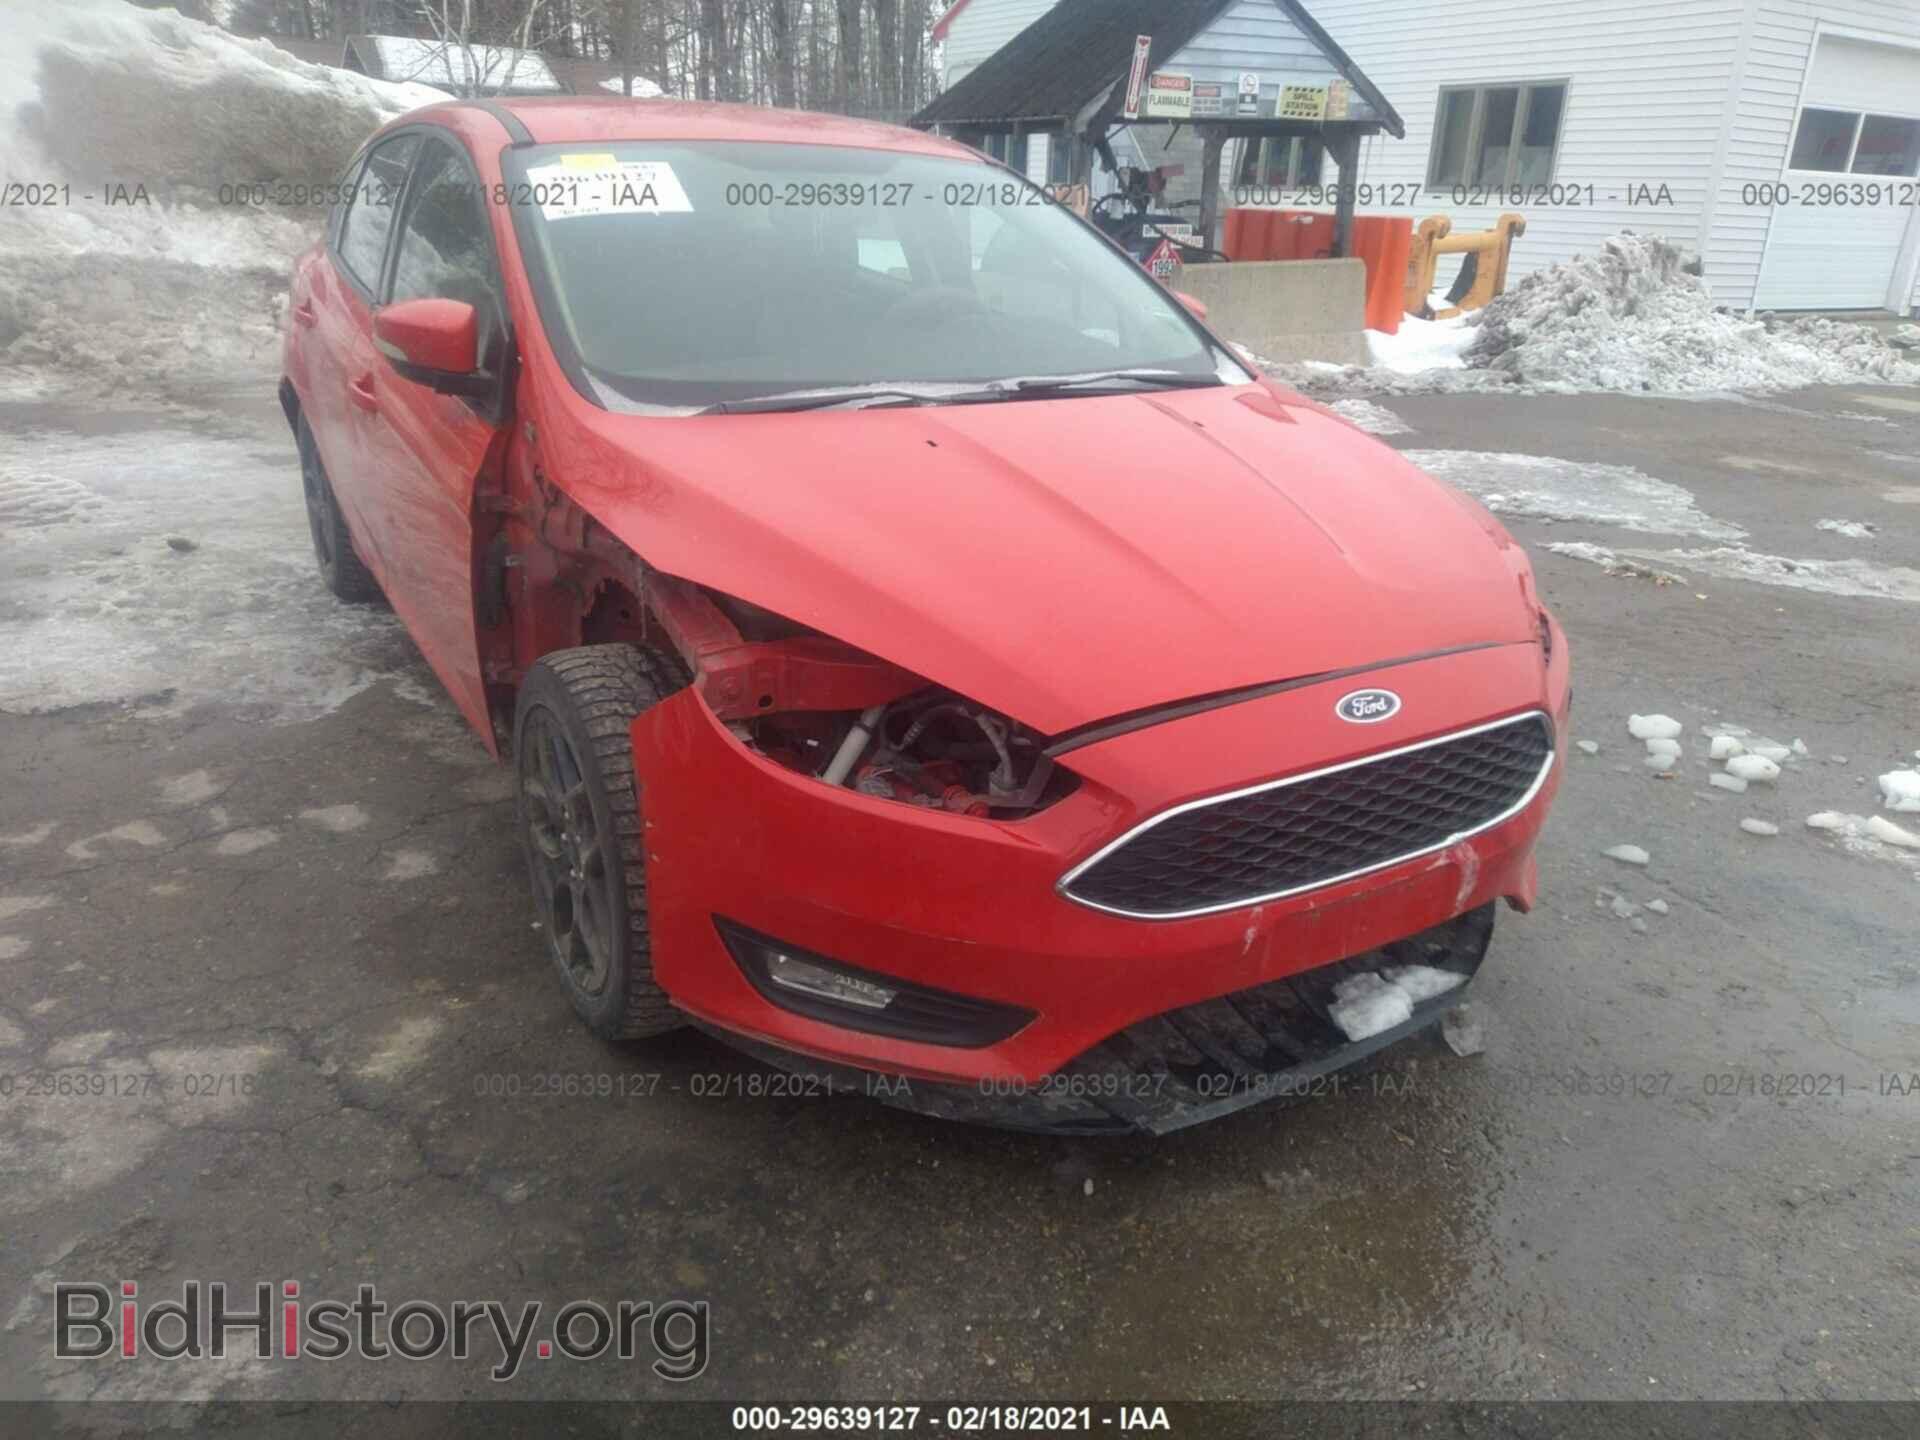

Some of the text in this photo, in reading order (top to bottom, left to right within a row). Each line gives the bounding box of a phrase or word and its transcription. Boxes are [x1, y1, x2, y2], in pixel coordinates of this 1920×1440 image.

[1149, 95, 1190, 107] FLAMMABLE
[1293, 93, 1316, 102] SPILL
[1286, 101, 1319, 111] STATION
[1352, 695, 1387, 716] Ford
